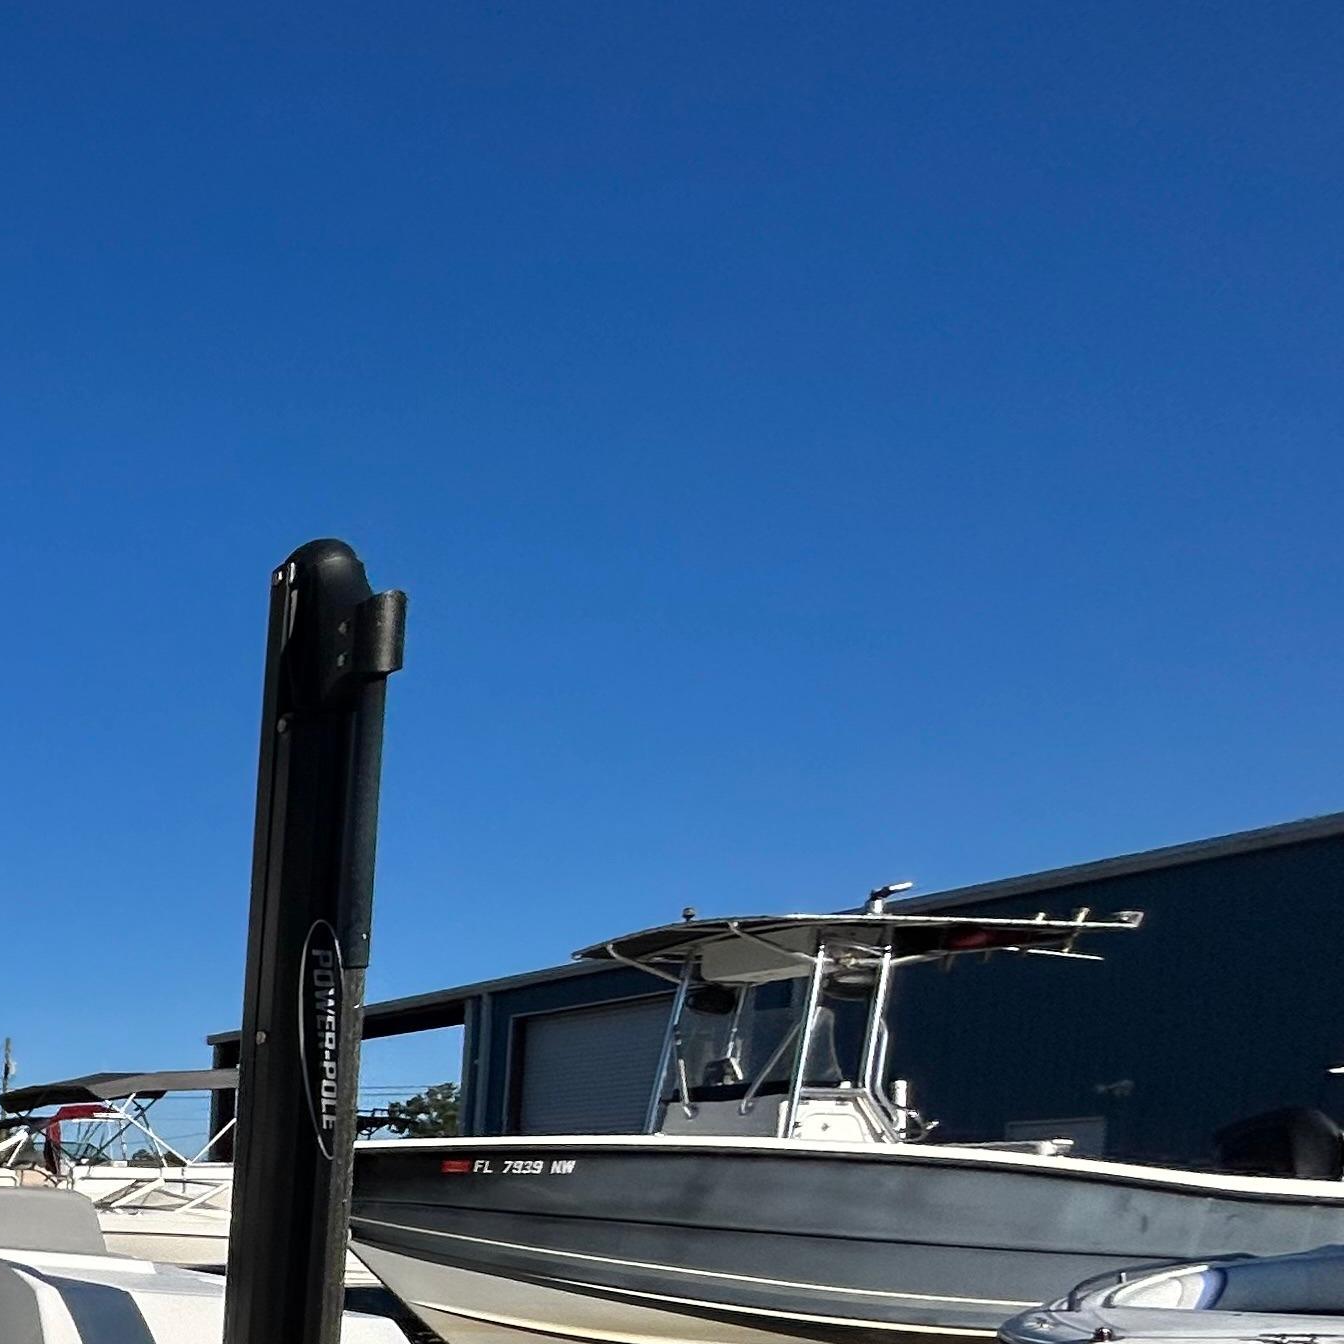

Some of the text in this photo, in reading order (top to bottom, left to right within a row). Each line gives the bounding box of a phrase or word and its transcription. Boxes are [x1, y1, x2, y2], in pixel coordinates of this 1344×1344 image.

[312, 949, 338, 1130] POWER-POLE
[473, 1160, 576, 1174] FL 7939 NW
